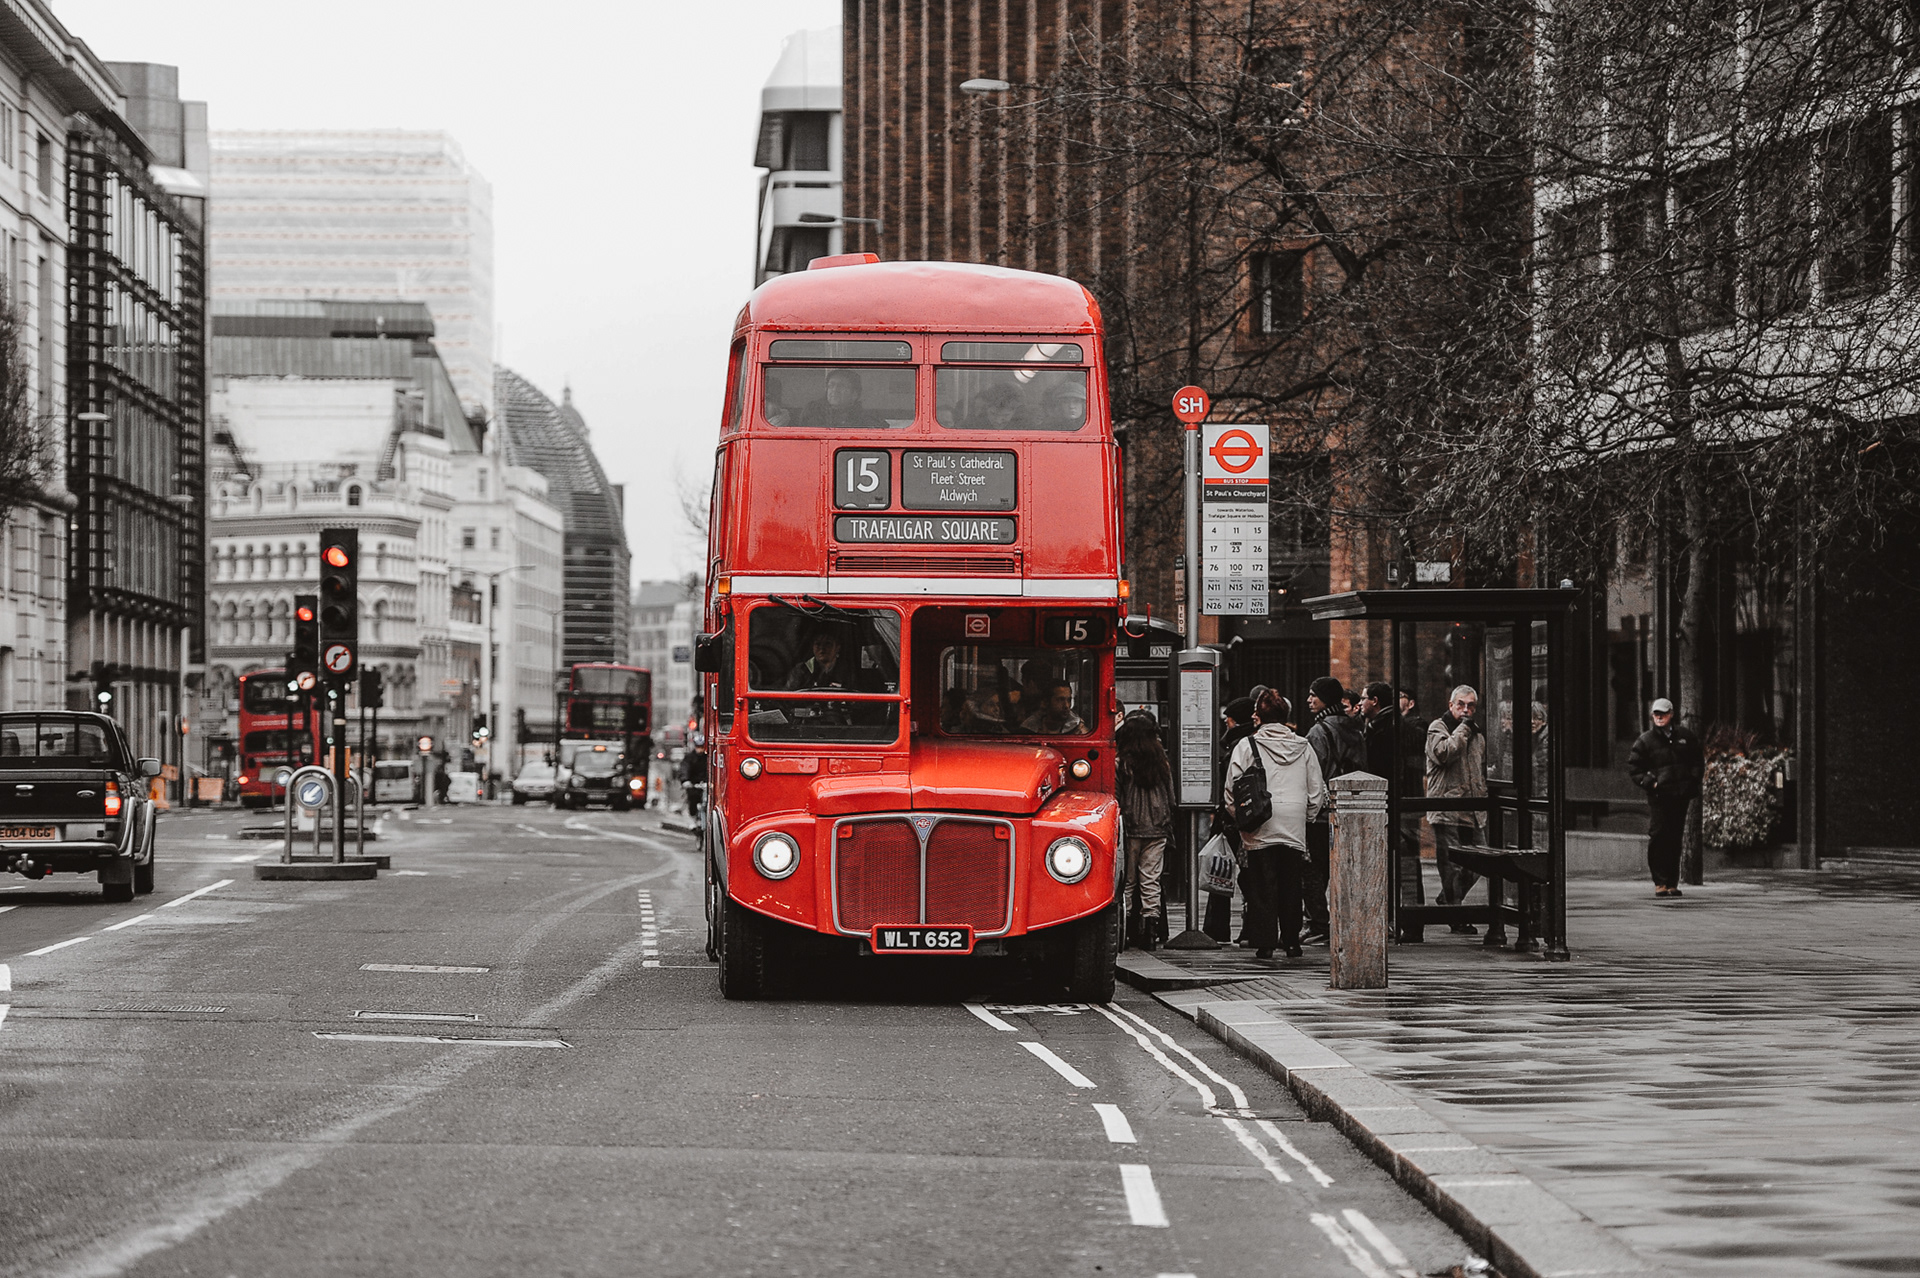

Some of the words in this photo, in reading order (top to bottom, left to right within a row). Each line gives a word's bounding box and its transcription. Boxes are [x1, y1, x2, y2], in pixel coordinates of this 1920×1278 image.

[1178, 396, 1204, 414] SH
[913, 455, 923, 468] St
[927, 456, 956, 469] Paul's
[959, 456, 1004, 470] Cathedral
[847, 457, 880, 493] 15
[930, 472, 954, 485] Fleet
[958, 473, 986, 486] Street
[939, 489, 978, 505] Aldwych
[1233, 490, 1266, 498] Churchyard
[850, 519, 934, 540] TRAFALGAR
[941, 520, 999, 541] SQUARE
[1210, 545, 1218, 553] 17
[1231, 545, 1241, 553] 23
[1253, 545, 1263, 553] 26
[1209, 563, 1219, 571] 76
[1229, 563, 1243, 571] 100
[1252, 563, 1264, 571] 172
[1206, 602, 1222, 610] N26
[1228, 602, 1244, 610] N47
[1065, 619, 1089, 641] 15
[1116, 647, 1172, 656] TEONE
[29, 828, 51, 838] UGG
[884, 931, 921, 948] WLT
[924, 931, 962, 948] 652
